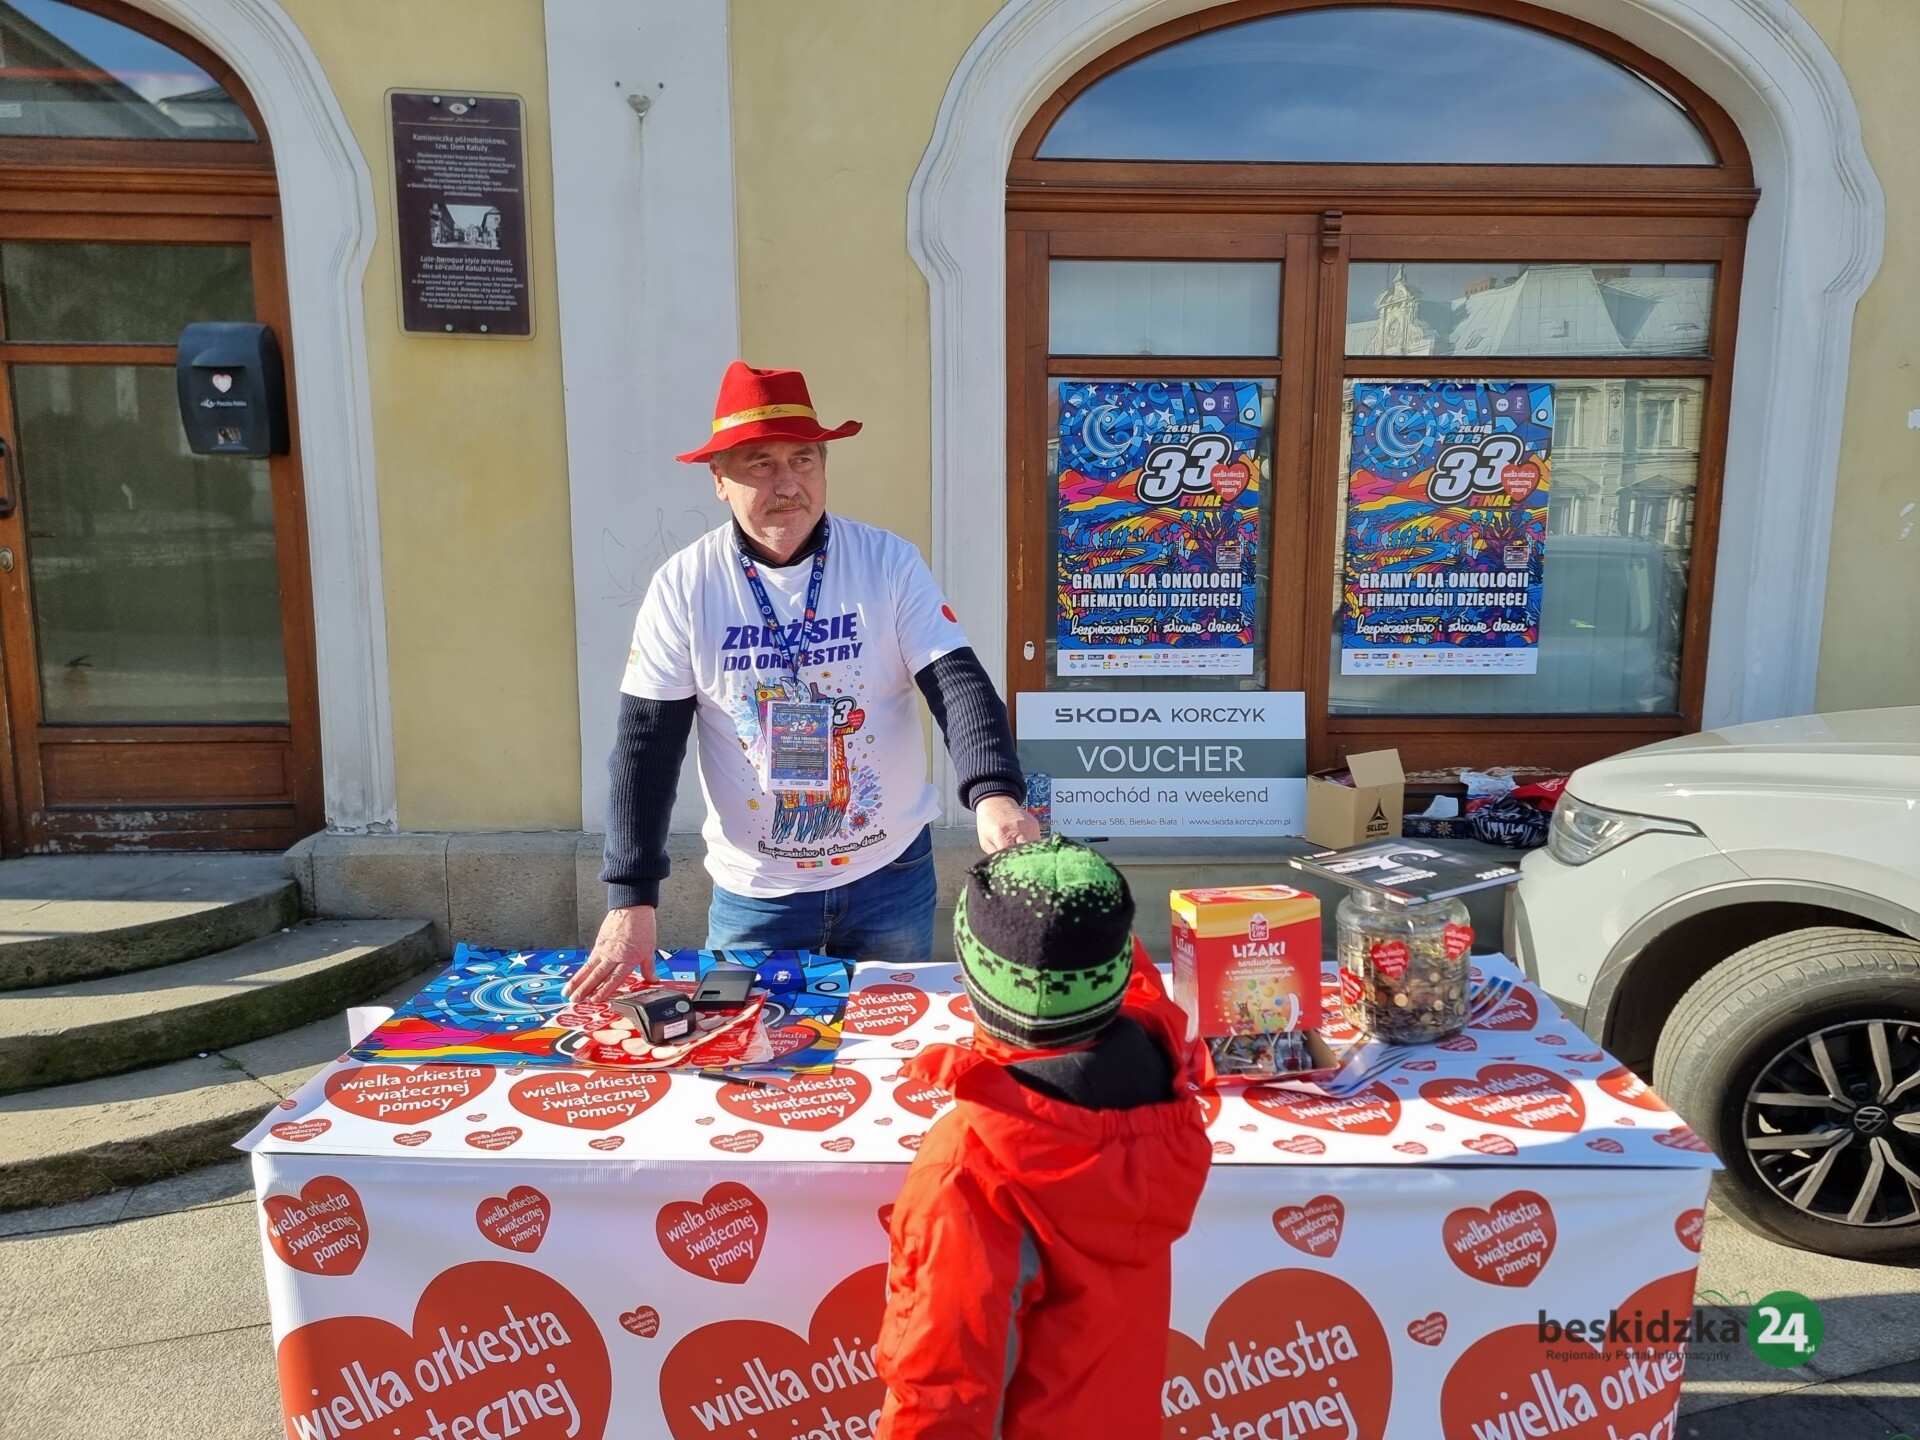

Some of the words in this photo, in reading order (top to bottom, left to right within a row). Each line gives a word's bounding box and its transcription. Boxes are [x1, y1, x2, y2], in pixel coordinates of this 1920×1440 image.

[413, 133, 453, 143] Kamieniczka
[421, 255, 463, 266] Late-baroque
[465, 257, 479, 265] style
[435, 263, 464, 271] so-called
[493, 265, 513, 273] House
[1153, 433, 1189, 444] 2025
[1446, 434, 1482, 444] 2025
[1140, 437, 1230, 502] 33
[1433, 437, 1520, 501] 33
[1072, 573, 1125, 589] GRAMY
[1129, 573, 1158, 589] DLA
[1161, 572, 1242, 588] ONKOLOGII
[1359, 573, 1412, 588] GRAMY
[1416, 573, 1444, 588] DLA
[1449, 572, 1529, 588] ONKOLOGII
[1072, 594, 1077, 608] I
[1080, 593, 1167, 608] HEMATOLOGII
[1171, 593, 1242, 609] DZIECIĘCEJ
[1358, 593, 1363, 607] I
[1367, 593, 1453, 607] HEMATOLOGII
[1457, 593, 1527, 608] DZIECIĘCEJ
[804, 621, 813, 633] 112
[809, 612, 858, 642] SIĘ
[1207, 617, 1243, 633] dzieci
[1492, 617, 1527, 632] dzieci
[724, 655, 752, 671] DO
[756, 642, 863, 669] ORESTRY
[789, 720, 807, 732] 33
[1171, 707, 1265, 723] KORCZYK
[1077, 745, 1245, 772] VOUCHER
[1055, 786, 1150, 803] samochód
[1158, 791, 1178, 803] na
[1185, 786, 1268, 803] weekend
[1075, 817, 1107, 826] Andersa
[1109, 817, 1127, 828] 586,
[1129, 817, 1178, 826] Bielsko-Biała
[1188, 817, 1292, 828] www.skoda.korczyk.com.pl
[1367, 822, 1389, 832] SELECT
[1251, 923, 1267, 931] Fine
[1252, 930, 1266, 938] Life
[1232, 941, 1286, 958] LIZAKI
[1238, 958, 1282, 968] serduszka
[845, 1002, 918, 1020] wiątecznej
[858, 991, 917, 1007] orkiestra
[769, 1031, 807, 1039] orkiestra
[854, 1014, 909, 1032] pomocy
[770, 1039, 799, 1048] ecznej
[340, 1074, 401, 1091] wielka
[405, 1066, 482, 1086] orkiestra
[522, 1083, 581, 1099] wielka
[584, 1072, 657, 1091] orkiestra
[729, 1087, 784, 1103] wielka
[788, 1075, 857, 1094] orkiestra
[1437, 1085, 1487, 1107] wielka
[1487, 1072, 1550, 1095] orkiestra
[356, 1080, 470, 1104] świątecznej
[542, 1086, 651, 1111] świątecznej
[752, 1089, 855, 1114] świątecznej
[906, 1086, 951, 1103] wielk
[1469, 1087, 1573, 1117] świątecznej
[378, 1096, 454, 1117] pomocy
[566, 1102, 637, 1123] pomocy
[779, 1103, 846, 1126] pomocy
[1511, 1101, 1580, 1128] pomocy
[1326, 1108, 1393, 1131] pomocy
[270, 1207, 308, 1238] wielka
[306, 1193, 350, 1217] orkiestra
[483, 1205, 509, 1227] wielka
[508, 1194, 541, 1212] orkiestra
[495, 1204, 545, 1238] świątecznej
[666, 1210, 706, 1242] wielka
[705, 1197, 753, 1221] orkiestra
[287, 1211, 361, 1256] świątecznej
[511, 1223, 541, 1248] pomocy
[685, 1210, 759, 1260] świątecznej
[1453, 1220, 1493, 1254] wielka
[1491, 1202, 1542, 1234] orkiestra
[312, 1233, 362, 1269] pomocy
[708, 1239, 754, 1276] pomocy
[1473, 1222, 1548, 1269] świątecznej
[1495, 1251, 1541, 1282] pomocy
[1204, 1320, 1359, 1400] orkiestra
[291, 1360, 414, 1440] wielka
[415, 1305, 572, 1393] orkiestra
[392, 1363, 582, 1440] tecznej
[690, 1357, 810, 1432] wielka
[1471, 1368, 1598, 1440] wielka
[1601, 1342, 1686, 1410] orkie
[1180, 1376, 1358, 1440] tecznej
